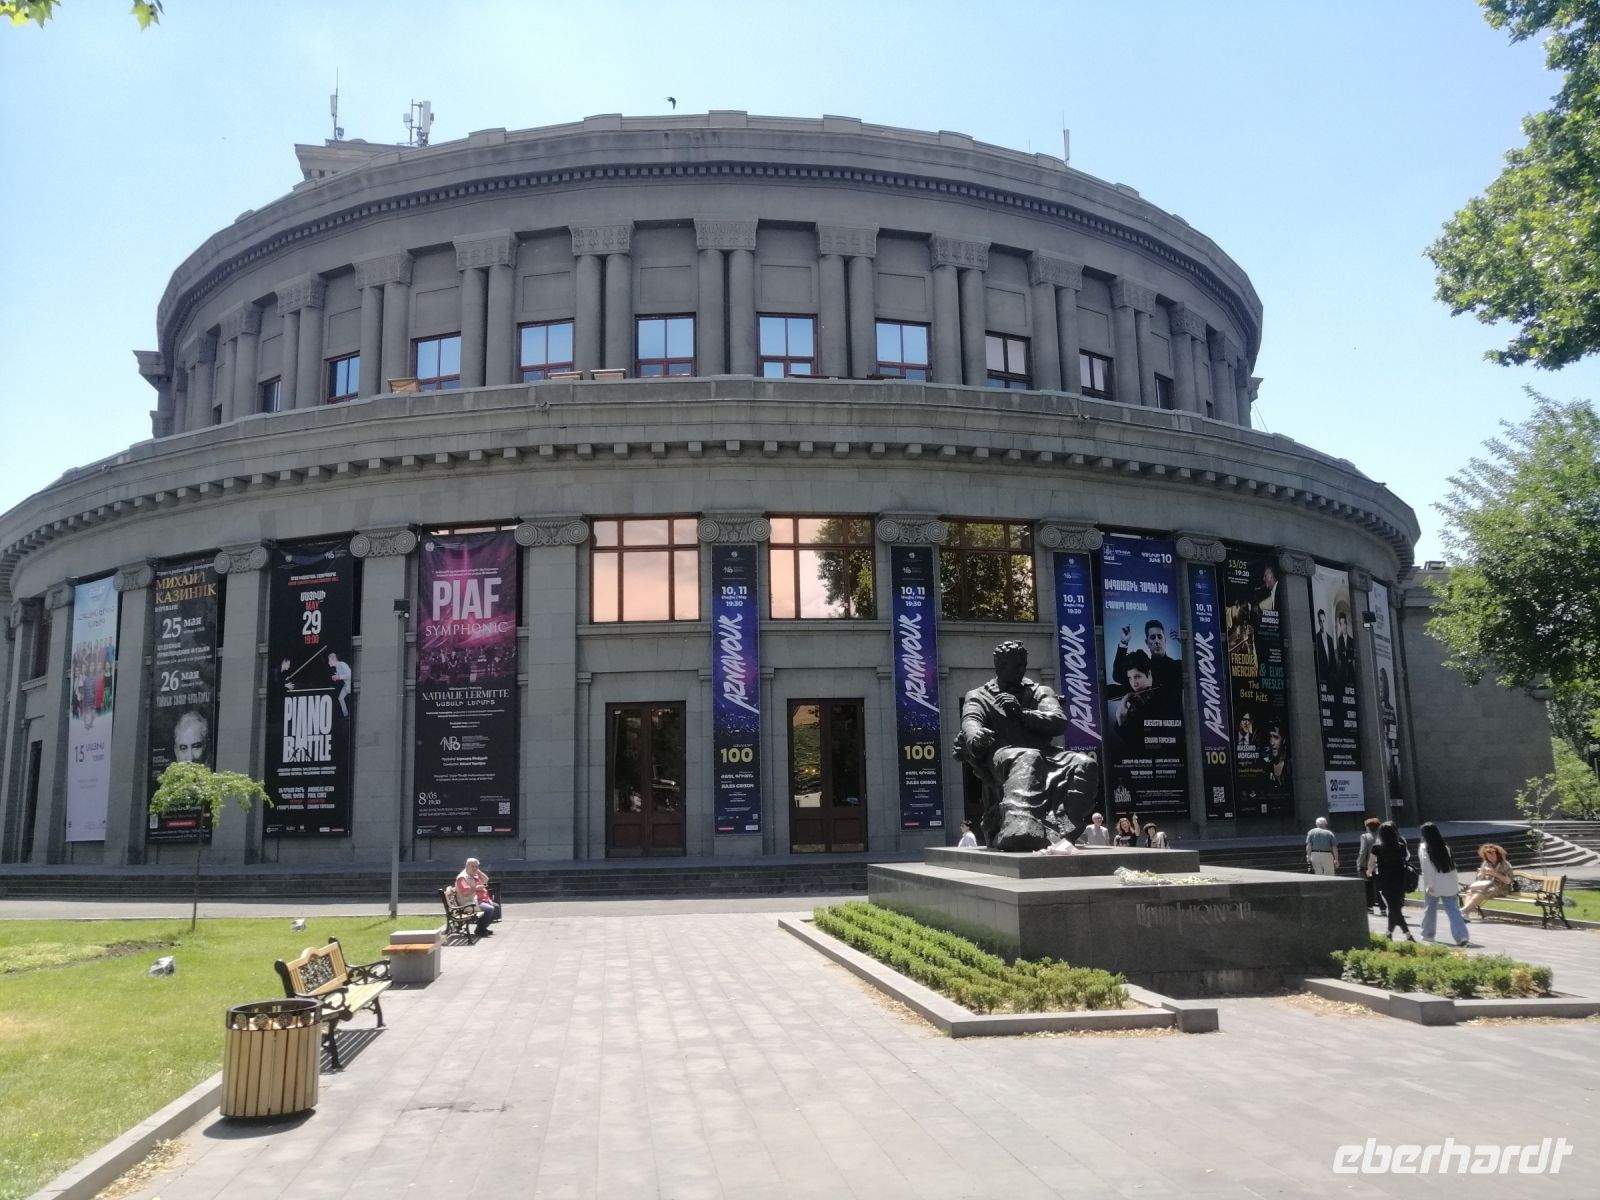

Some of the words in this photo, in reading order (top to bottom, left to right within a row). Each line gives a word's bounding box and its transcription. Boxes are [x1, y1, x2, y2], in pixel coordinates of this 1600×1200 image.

[1161, 554, 1172, 564] 10
[1228, 560, 1248, 570] 13/05
[155, 571, 206, 590] МИХАИЛ
[155, 583, 216, 604] КАЗИНИК
[738, 586, 748, 595] 11
[917, 586, 926, 595] 11
[306, 601, 320, 610] MAY
[432, 578, 502, 621] PIAF
[1076, 595, 1084, 603] 11
[1206, 604, 1212, 612] 11
[163, 618, 182, 638] 25
[184, 618, 202, 628] мая
[302, 610, 322, 635] 29
[426, 622, 508, 636] SYMPHONIC
[1232, 653, 1256, 664] FREDDIE
[1232, 666, 1258, 678] MERCURY
[160, 670, 180, 692] 26
[1248, 680, 1260, 690] The
[1262, 678, 1284, 690] PRESLEY
[422, 690, 464, 700] NATHALIE
[466, 689, 510, 698] LERMITTE
[1240, 689, 1254, 698] Best
[284, 694, 332, 736] PIANO
[74, 744, 84, 762] 15
[282, 734, 332, 762] BATTLE
[904, 745, 935, 760] 100
[720, 747, 753, 763] 100
[1206, 752, 1227, 765] 100
[1330, 778, 1338, 792] 20
